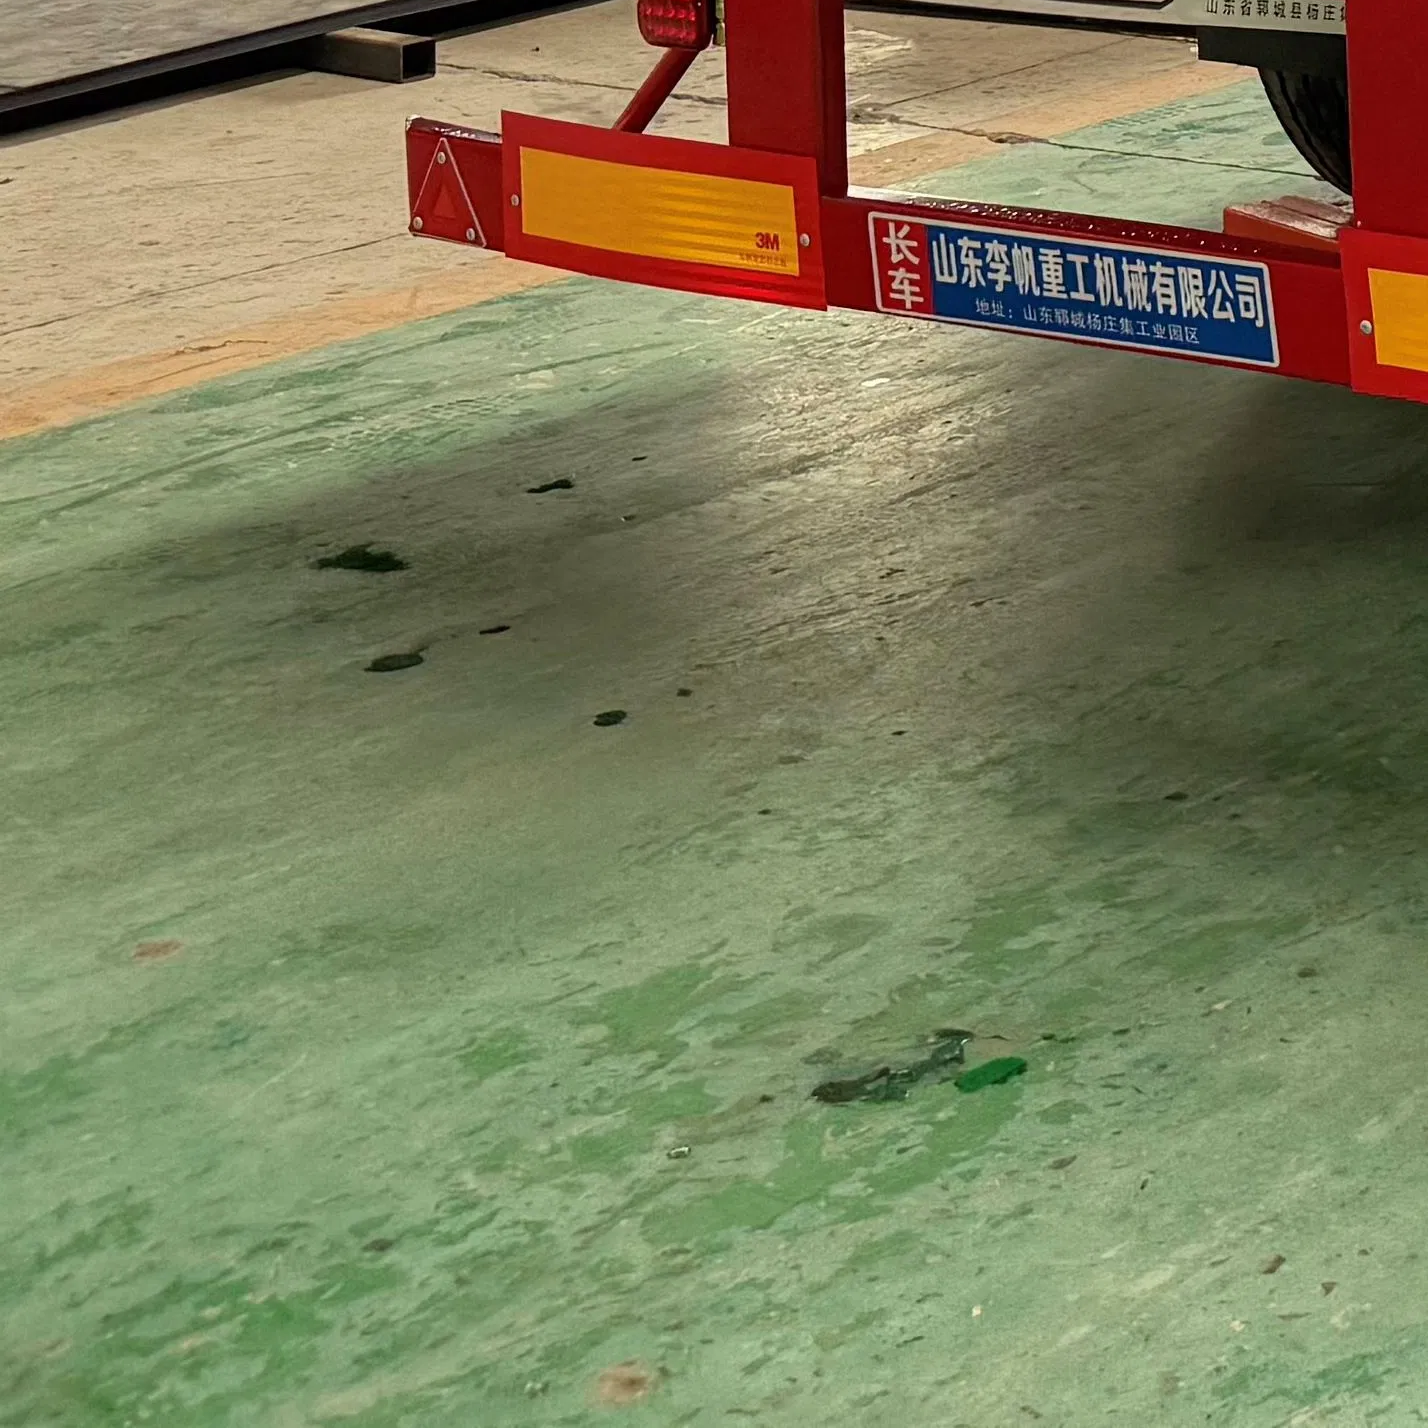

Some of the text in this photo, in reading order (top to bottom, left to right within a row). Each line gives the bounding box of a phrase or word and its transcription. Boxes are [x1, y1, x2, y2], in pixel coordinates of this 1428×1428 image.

[755, 232, 779, 252] 3M
[882, 221, 925, 310] 长车
[931, 232, 1266, 329] 山东李帆重工机械有限公司
